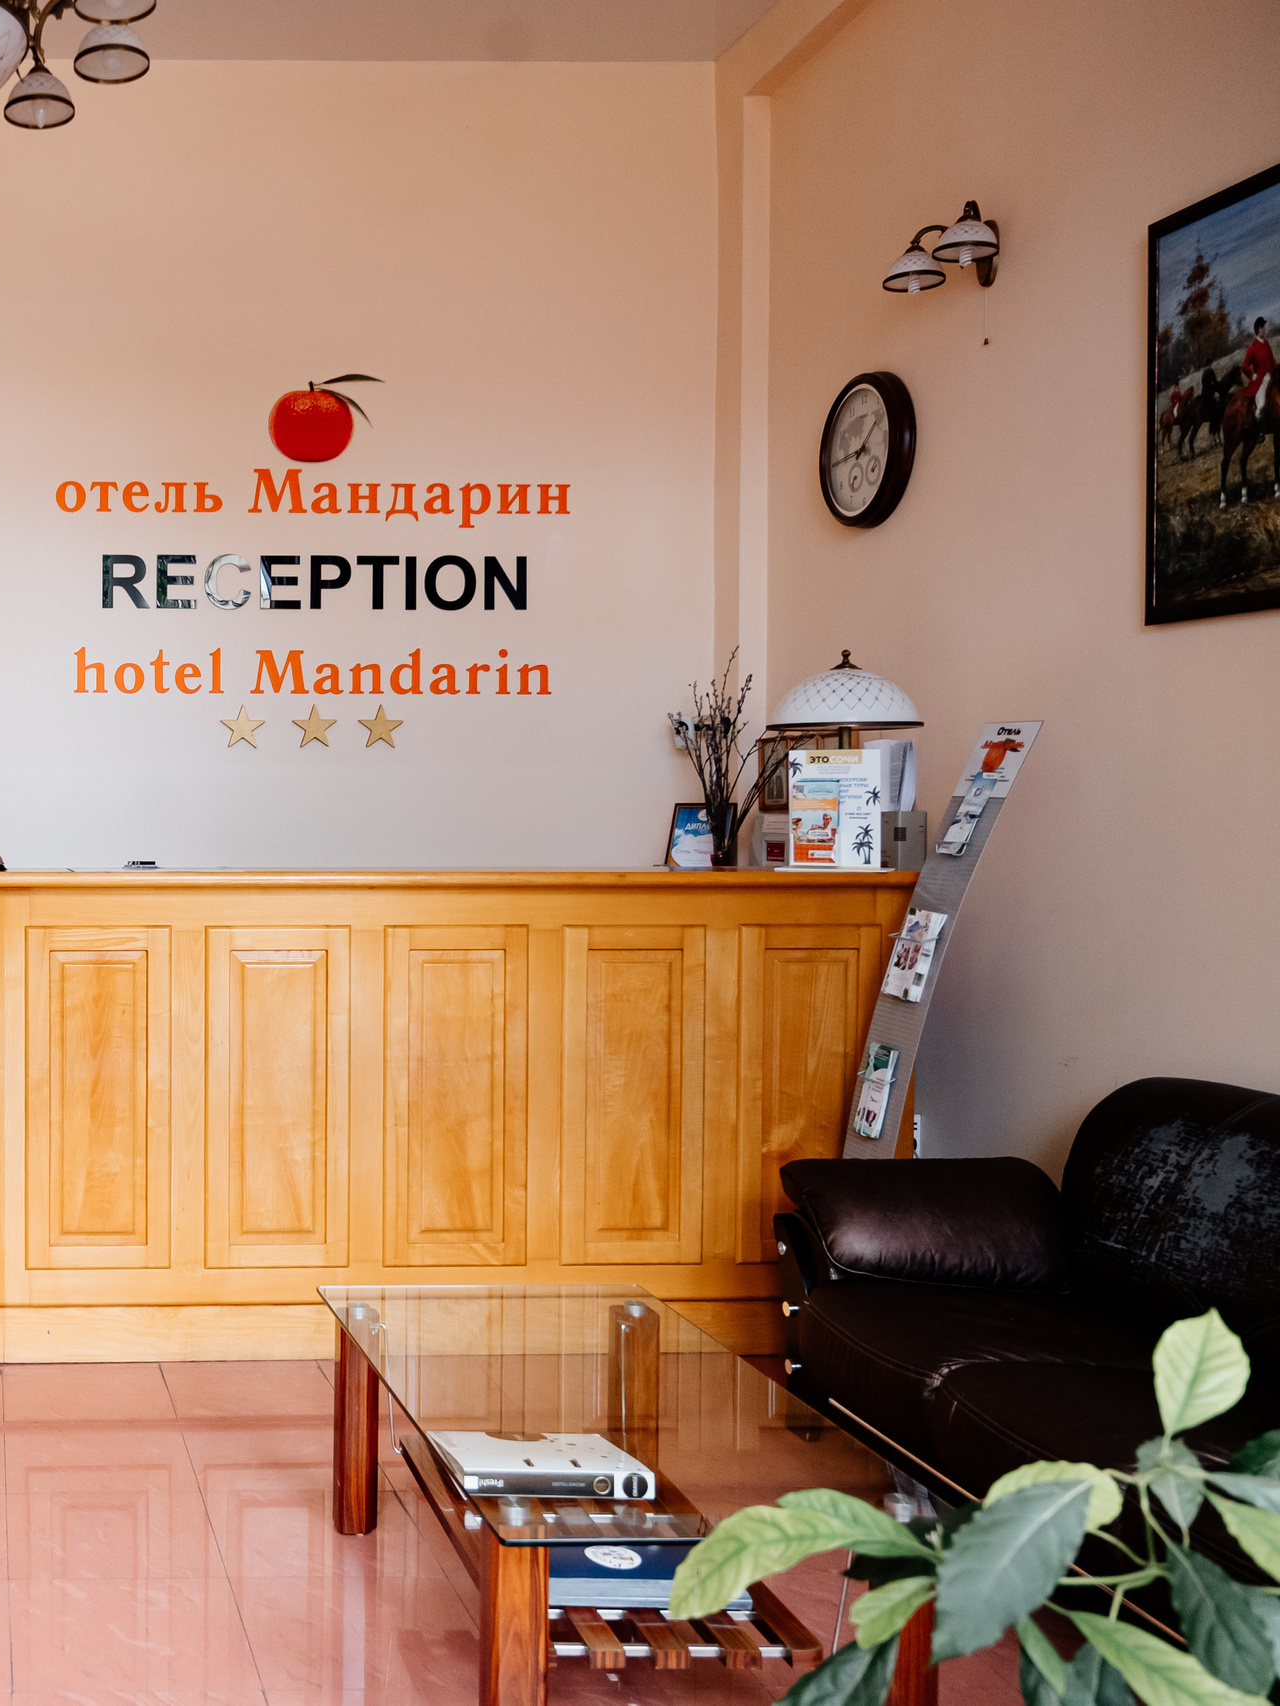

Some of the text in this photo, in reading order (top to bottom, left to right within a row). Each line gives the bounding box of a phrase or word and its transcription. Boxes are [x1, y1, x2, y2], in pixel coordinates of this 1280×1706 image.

[55, 468, 571, 528] отель Мандарин
[101, 553, 528, 611] RECEPTION
[73, 646, 552, 696] hotel Mandarin
[997, 727, 1021, 735] Отель
